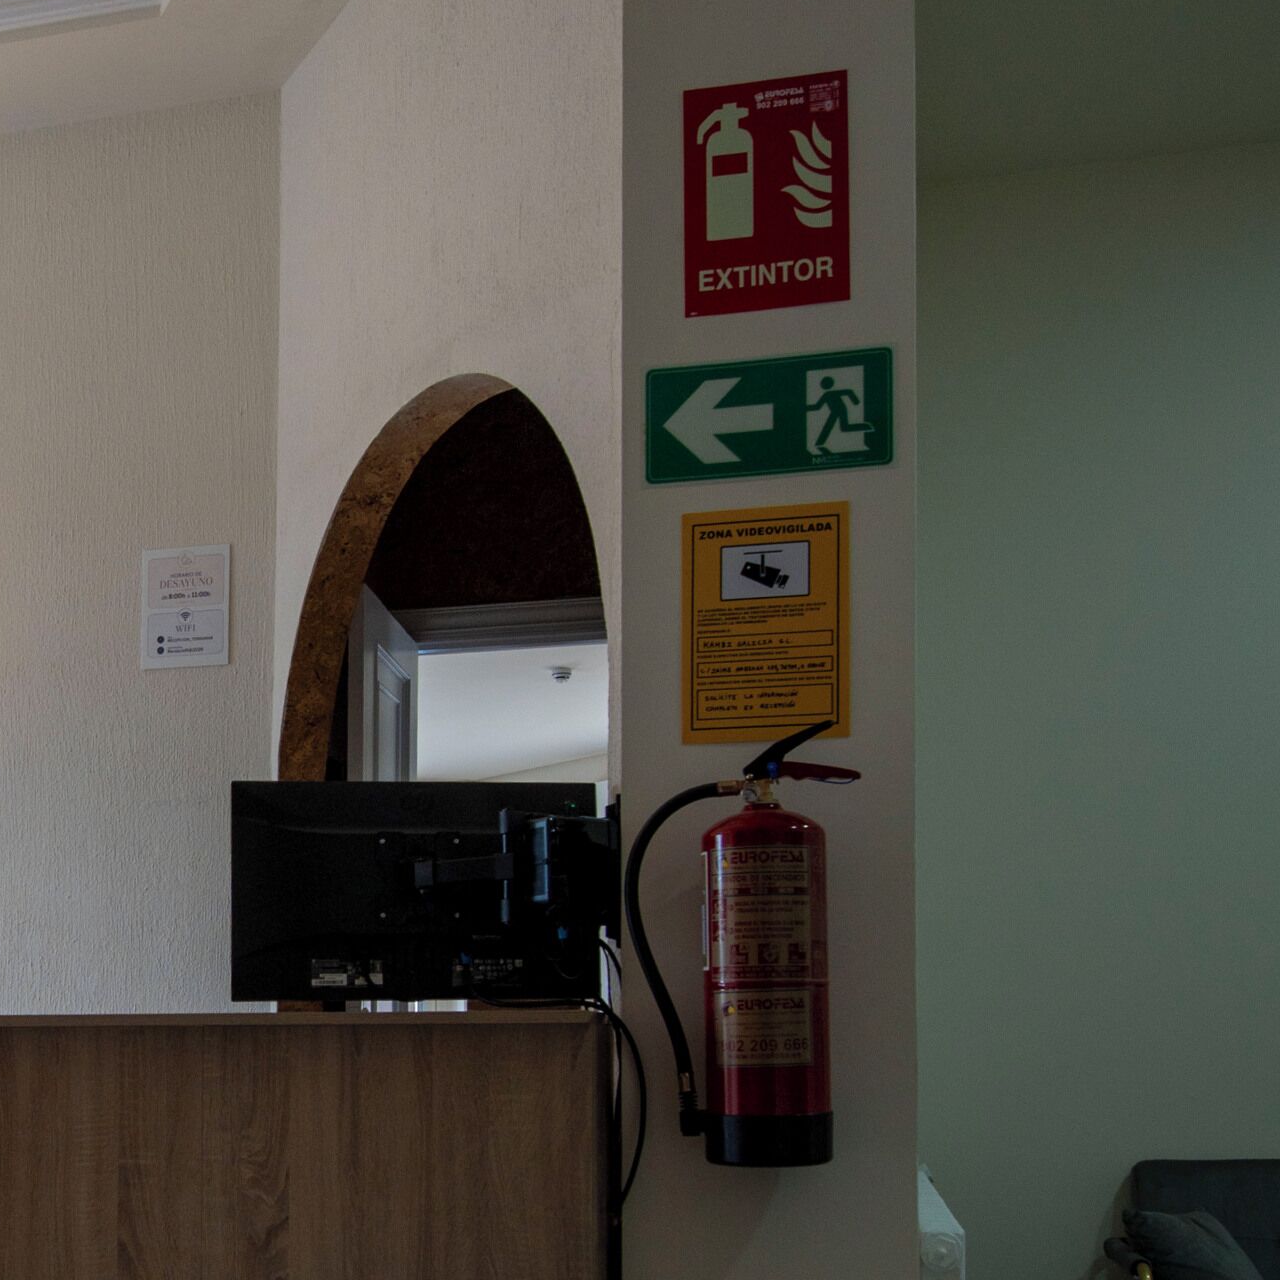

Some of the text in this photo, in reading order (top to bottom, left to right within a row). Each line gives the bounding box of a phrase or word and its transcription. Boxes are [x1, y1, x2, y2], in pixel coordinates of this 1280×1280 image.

[698, 256, 834, 293] EXTINTOR
[699, 522, 832, 540] ZONA VIDEOVIGILADA
[160, 577, 213, 589] DESAYUNO
[176, 624, 195, 632] WIFI
[731, 850, 804, 864] EUROFESA
[737, 998, 805, 1011] EUROFESA
[750, 1039, 777, 1052] 209
[784, 1038, 808, 1051] 666
